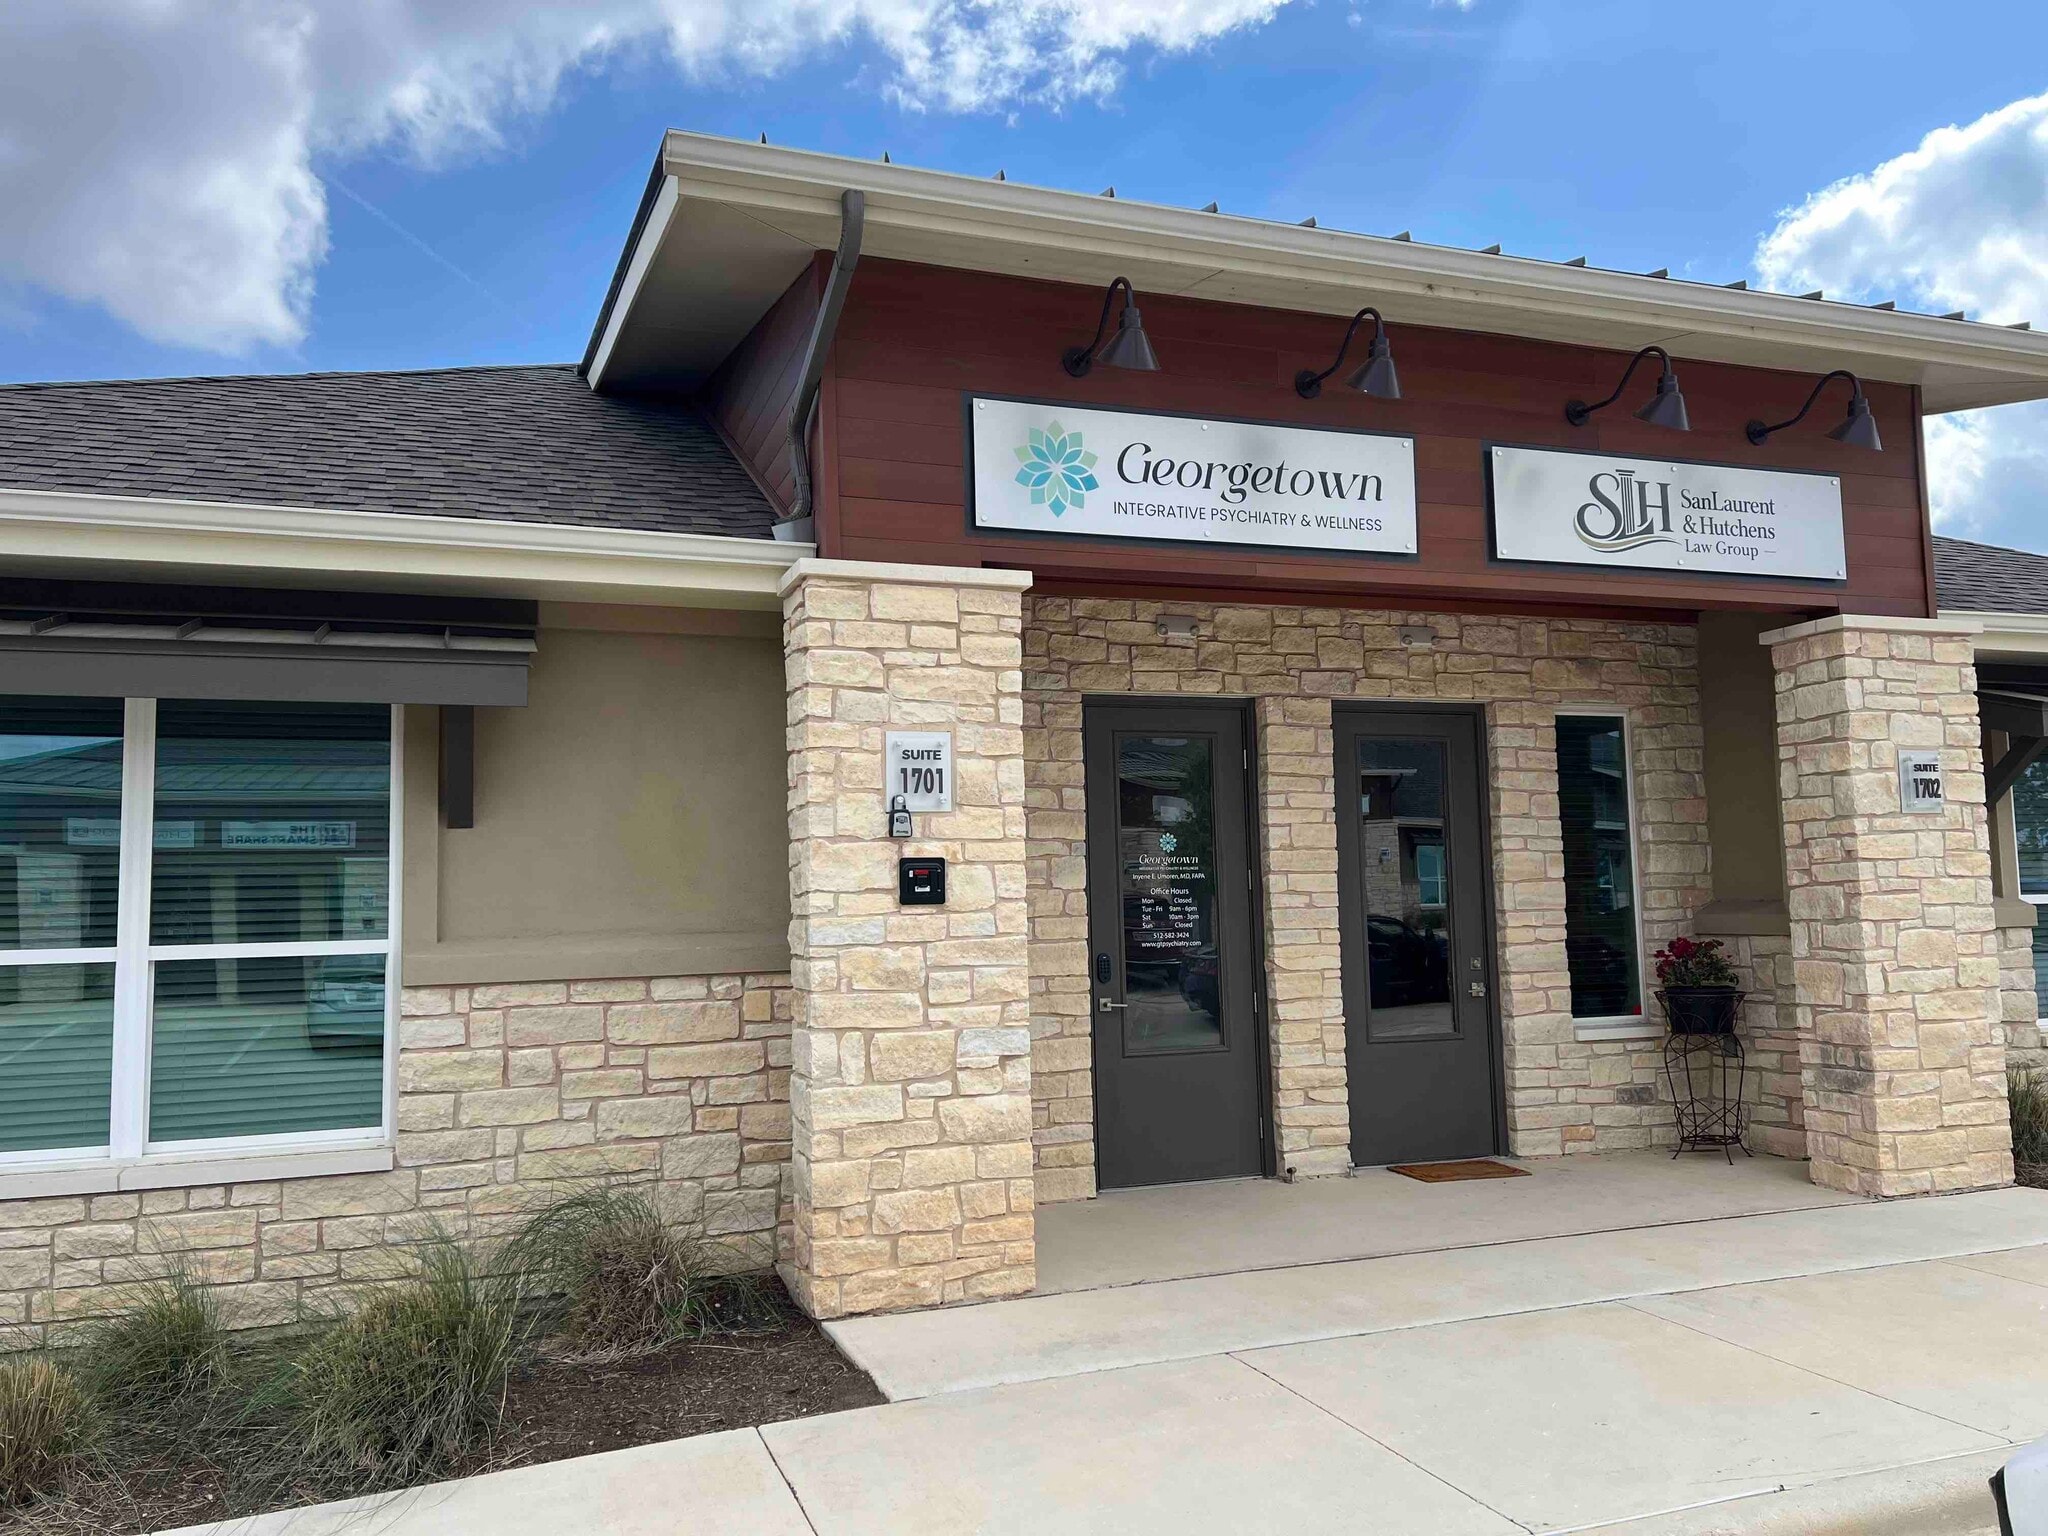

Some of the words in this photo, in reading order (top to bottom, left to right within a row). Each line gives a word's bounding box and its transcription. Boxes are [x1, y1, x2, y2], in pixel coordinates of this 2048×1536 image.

[1116, 442, 1383, 504] Georgetown
[1680, 488, 1776, 516] SanLaurent
[1113, 500, 1206, 521] INTEGRATIVE
[1210, 507, 1297, 528] PSYCHIATRY
[1300, 514, 1311, 528] &
[1314, 515, 1383, 532] WELLNESS
[1683, 515, 1698, 534] &
[1700, 516, 1776, 540] Hutchens
[1685, 538, 1713, 554] Law
[1715, 540, 1759, 561] Group
[901, 749, 942, 761] SUITE
[1913, 763, 1939, 773] SUITE
[900, 767, 944, 794] 1701
[1913, 777, 1942, 799] 1702
[1139, 854, 1199, 866] Georgetown
[1150, 887, 1170, 895] Office
[1170, 887, 1190, 895] Hours
